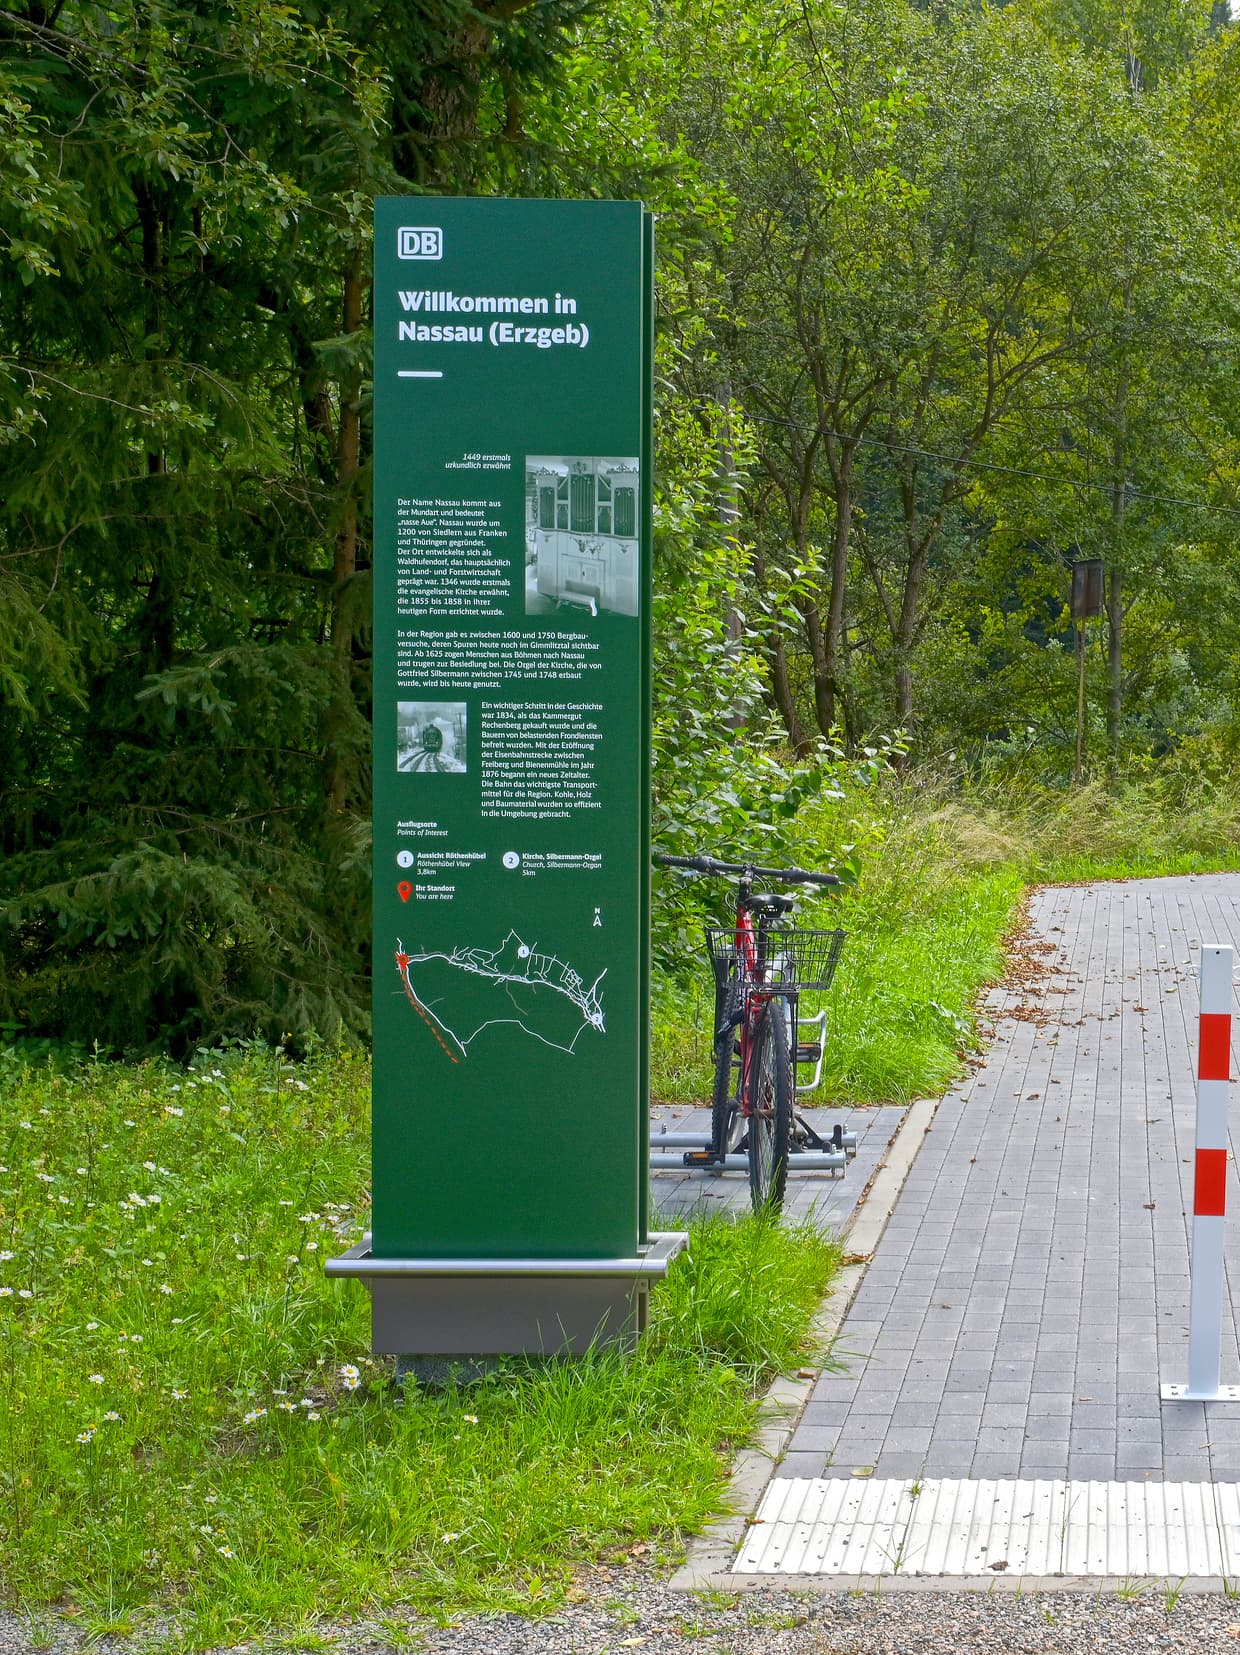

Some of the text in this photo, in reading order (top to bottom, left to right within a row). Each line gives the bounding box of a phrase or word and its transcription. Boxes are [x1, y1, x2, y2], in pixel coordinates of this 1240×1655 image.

[402, 231, 438, 255] DB
[398, 291, 577, 314] Willkommen in
[399, 321, 589, 348] Nassau (Erzgeb)
[412, 538, 448, 547] Thüringen
[397, 578, 423, 586] geprägt
[410, 588, 454, 596] evangelische
[397, 608, 428, 616] heutigen
[542, 713, 582, 721] Kammergut
[481, 722, 522, 730] Rechenberg
[522, 722, 548, 730] gekauft
[561, 742, 594, 750] Eröffnung
[481, 761, 510, 769] Freiberg
[500, 771, 526, 779] begann
[501, 810, 538, 818] Umgebung
[539, 810, 571, 819] gebracht.
